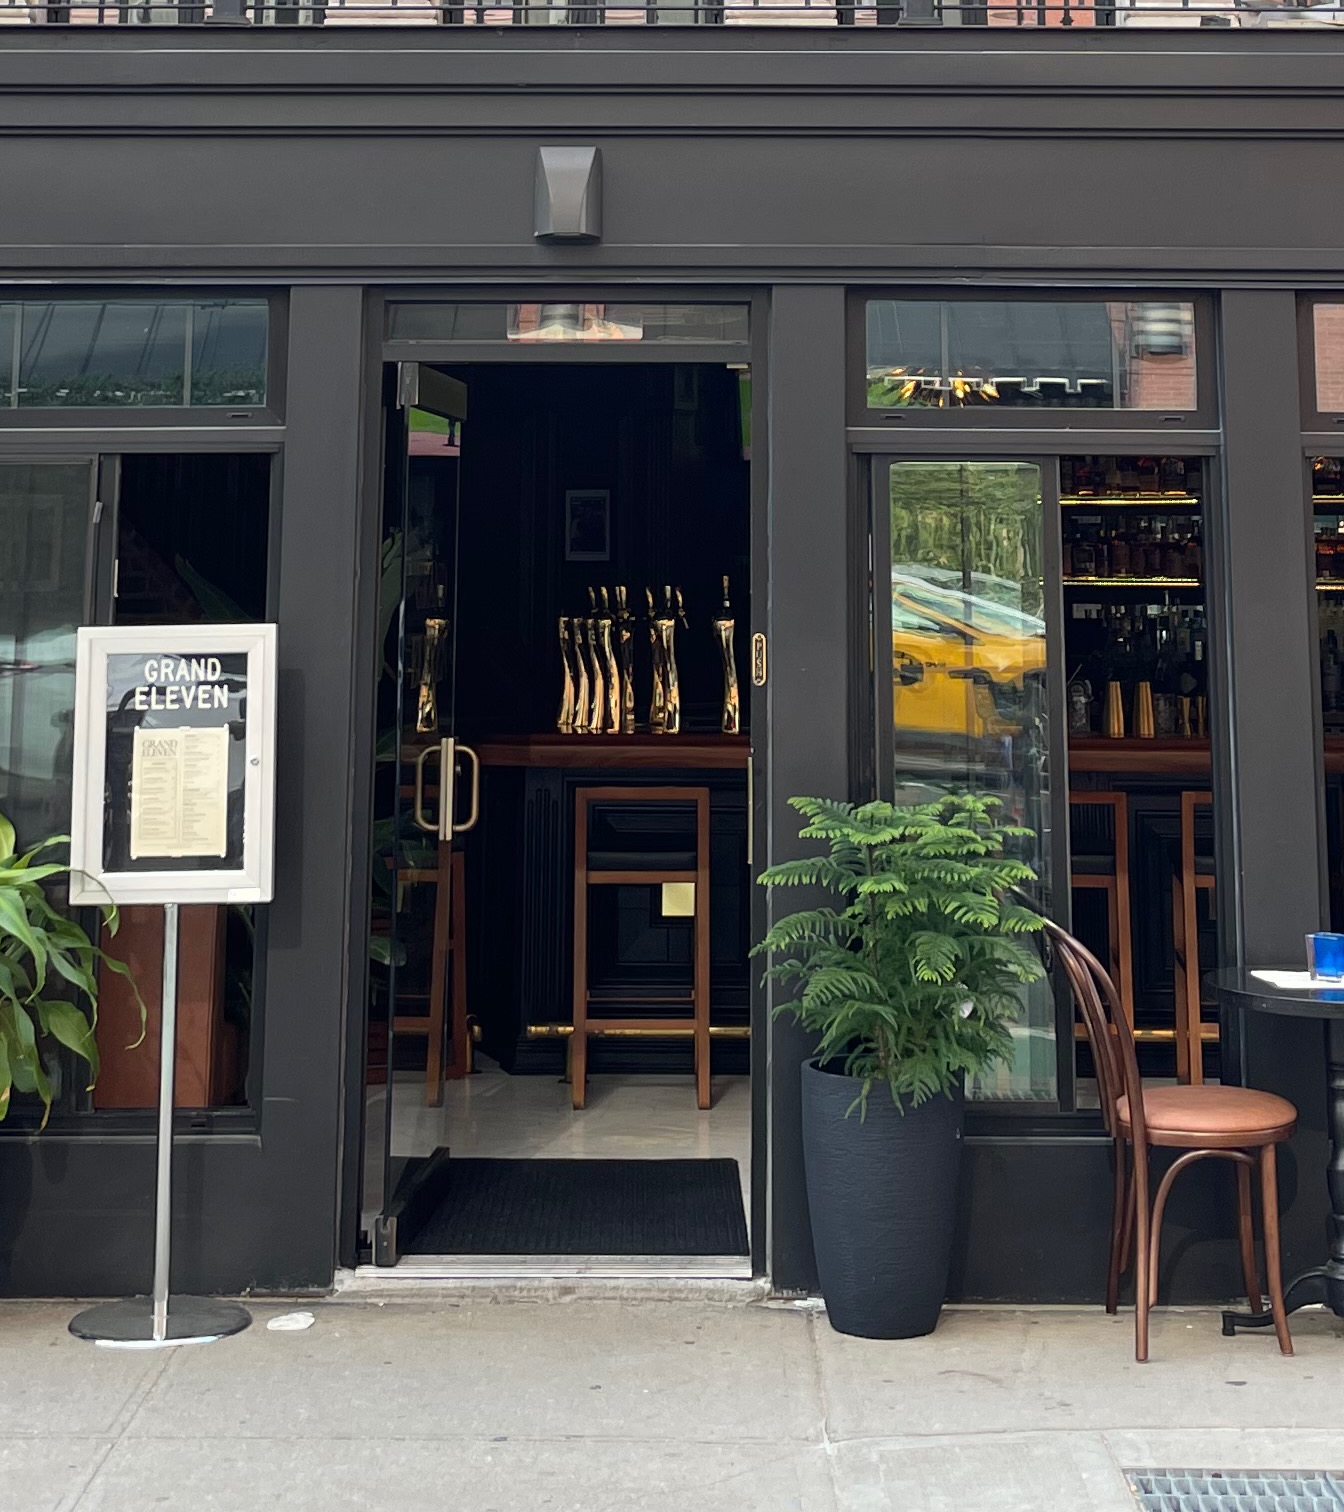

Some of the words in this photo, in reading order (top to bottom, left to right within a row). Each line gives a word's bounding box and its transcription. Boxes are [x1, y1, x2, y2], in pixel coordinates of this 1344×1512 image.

[144, 657, 222, 682] GRAND
[134, 684, 229, 711] ELEVEN
[142, 739, 178, 748] GRAND
